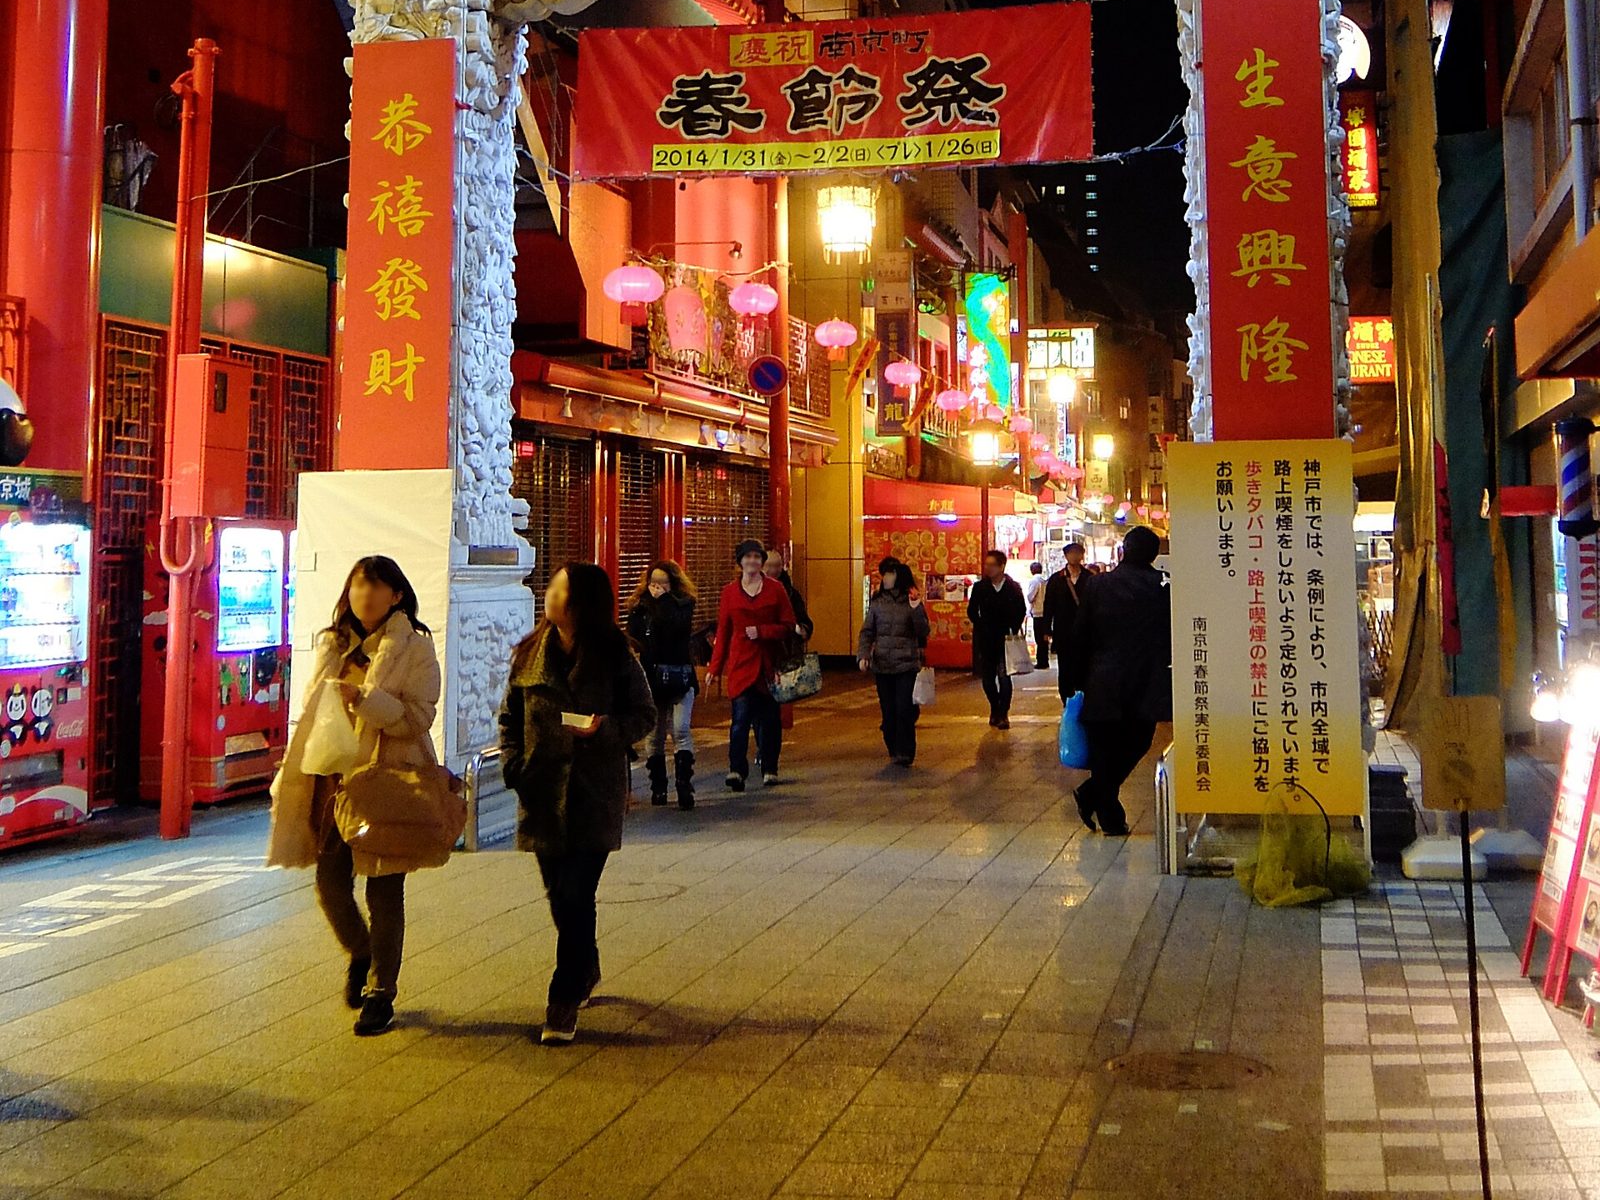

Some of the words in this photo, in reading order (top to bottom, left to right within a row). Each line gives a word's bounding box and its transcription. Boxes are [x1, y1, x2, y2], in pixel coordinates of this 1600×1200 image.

[657, 56, 1006, 138] 春節祭
[736, 34, 809, 64] 慶祝
[818, 29, 930, 60] 南京町
[363, 92, 434, 402] 恭禧發財
[1229, 47, 1310, 383] 生意興隆
[1346, 319, 1394, 346] 酒家
[1216, 460, 1236, 579] お願いします。
[1192, 616, 1211, 793] 南京町春節祭実行委員会
